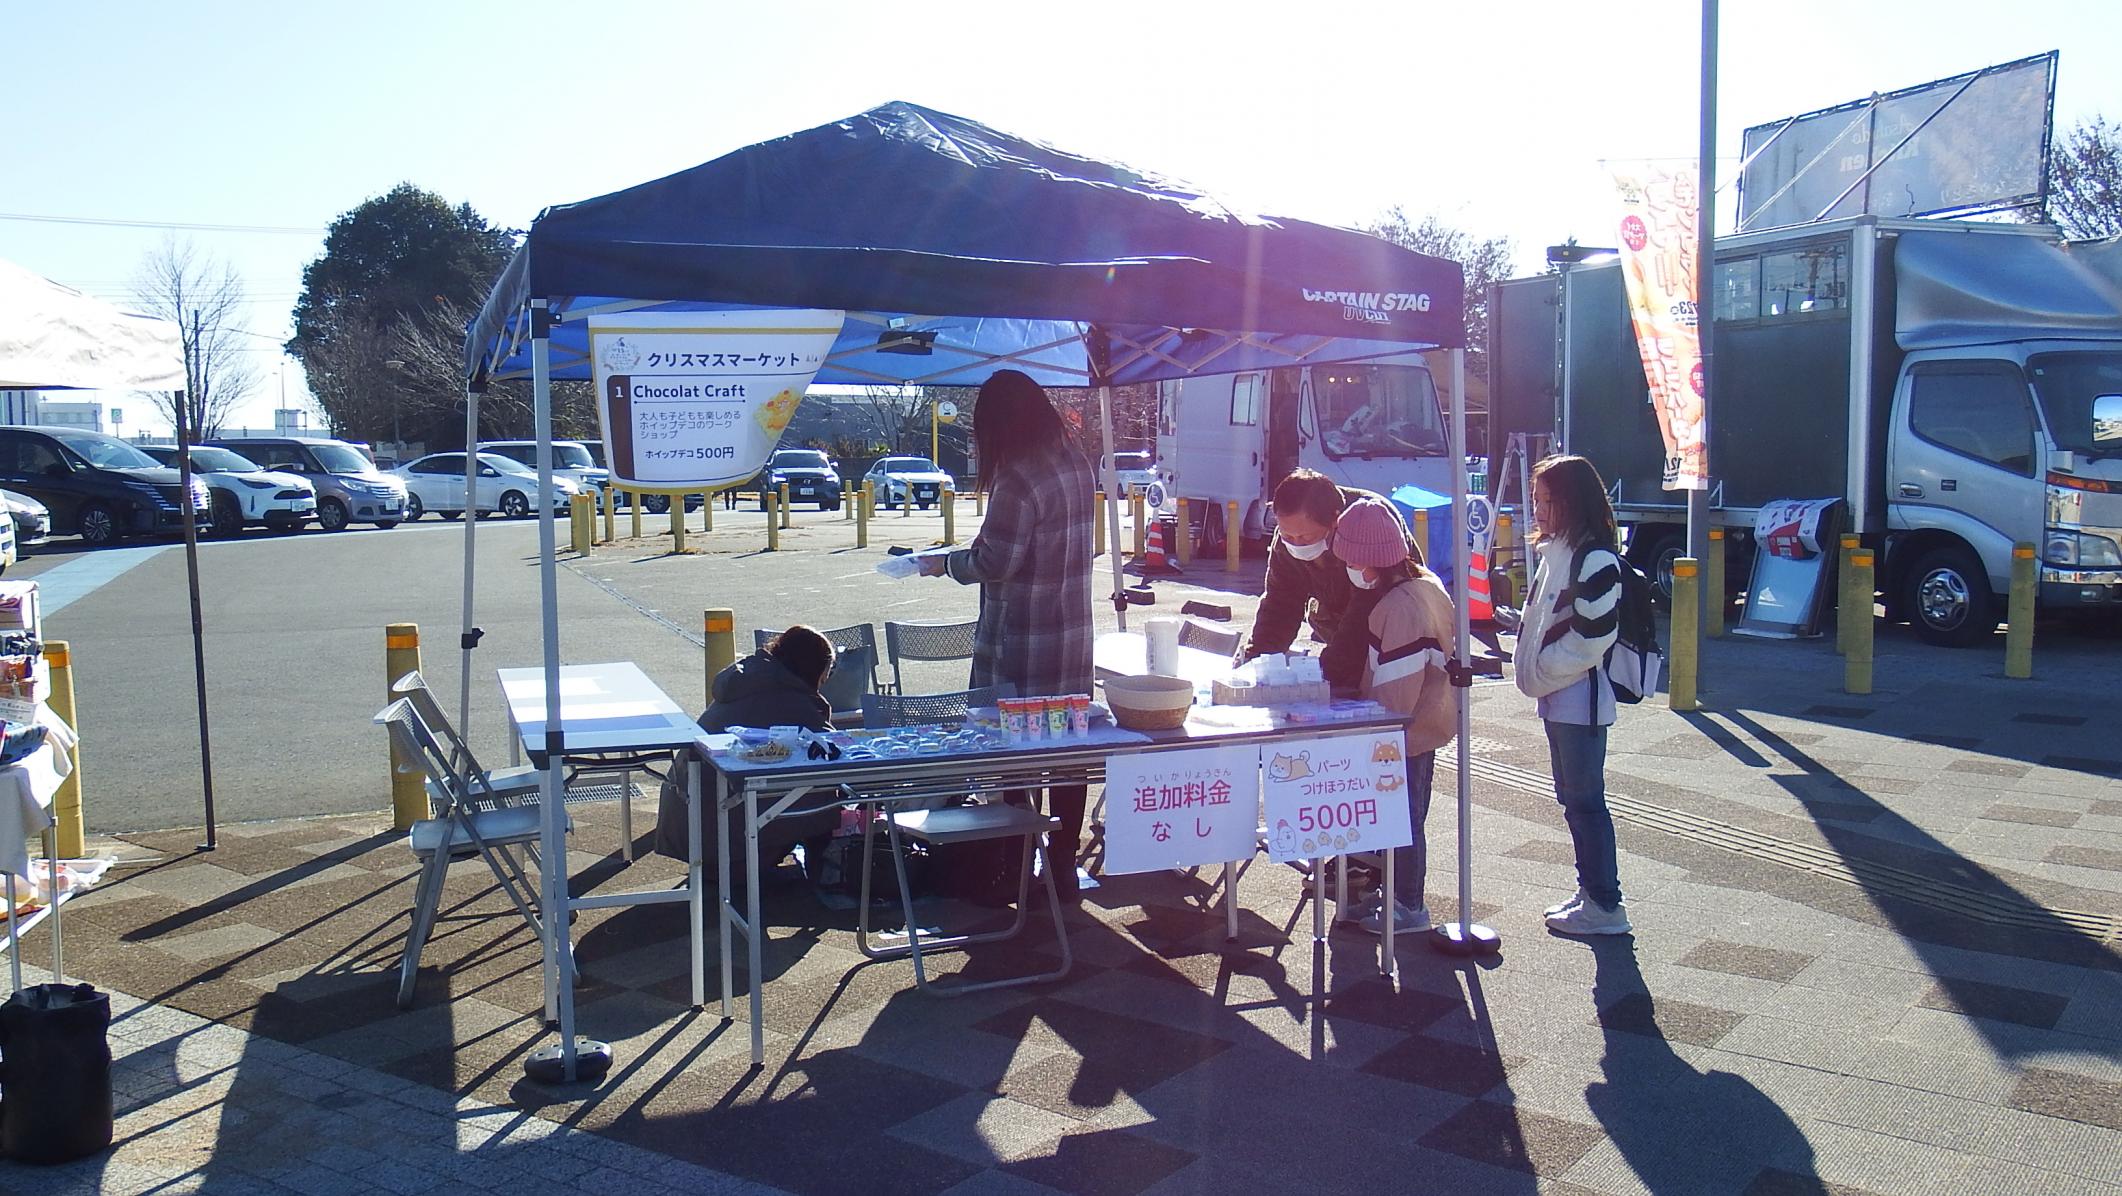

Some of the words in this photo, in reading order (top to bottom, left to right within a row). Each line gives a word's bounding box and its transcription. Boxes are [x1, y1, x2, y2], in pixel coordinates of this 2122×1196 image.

[1382, 292, 1431, 312] STAG
[648, 352, 800, 368] クリスマスマーケット
[615, 387, 624, 398] 1
[633, 385, 700, 398] Chocolat
[705, 384, 745, 398] Craft
[640, 411, 741, 420] 大人も子どもも楽しめる
[640, 421, 732, 430] ホイップデコのワーク
[640, 430, 678, 439] ショップ
[1300, 778, 1370, 796] つけほうだい
[1133, 780, 1231, 813] 追加料金
[1299, 799, 1377, 832] 500円
